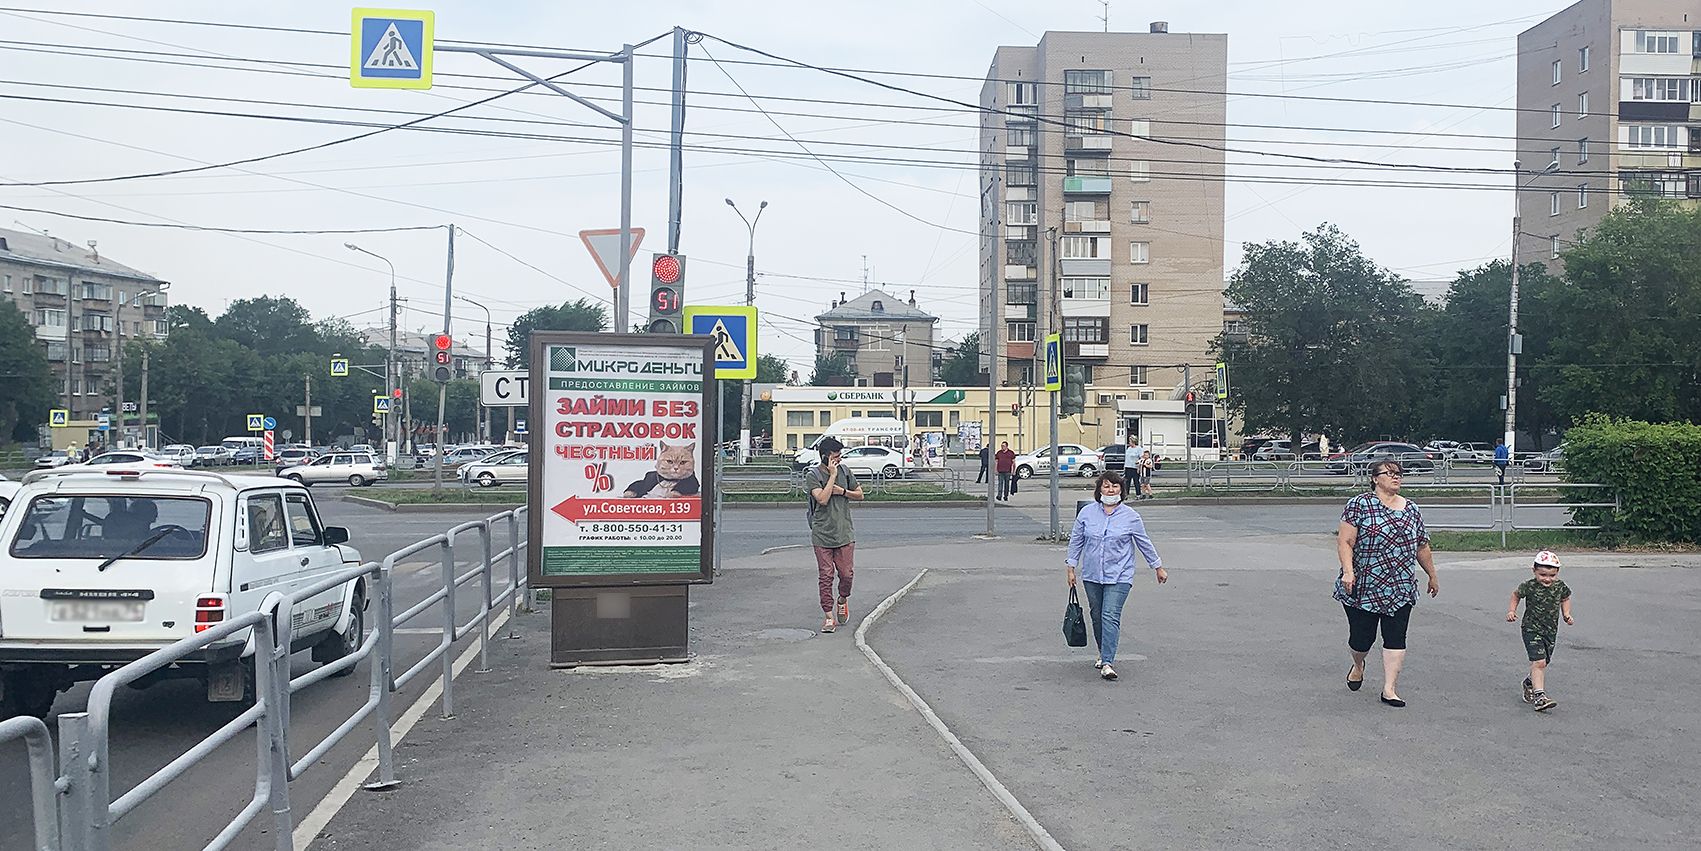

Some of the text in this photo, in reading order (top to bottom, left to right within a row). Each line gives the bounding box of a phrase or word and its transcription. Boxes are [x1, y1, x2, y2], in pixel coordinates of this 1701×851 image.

[658, 292, 678, 310] 51
[437, 353, 449, 363] 51
[495, 377, 529, 399] СТ
[561, 380, 700, 391] ПРЕДОСТАВЛЕНИЕ ЗАЙМОВ
[839, 392, 884, 400] СБЕРБАНК
[556, 394, 699, 418] ЗАЙМИ БЕЗ
[555, 421, 696, 439] СТРАХОВОК
[555, 443, 656, 460] ЧЕСТНЫЙ
[584, 464, 613, 492] %
[583, 502, 691, 516] ул.Советская, 139
[592, 524, 683, 532] 8-800-550-41-31
